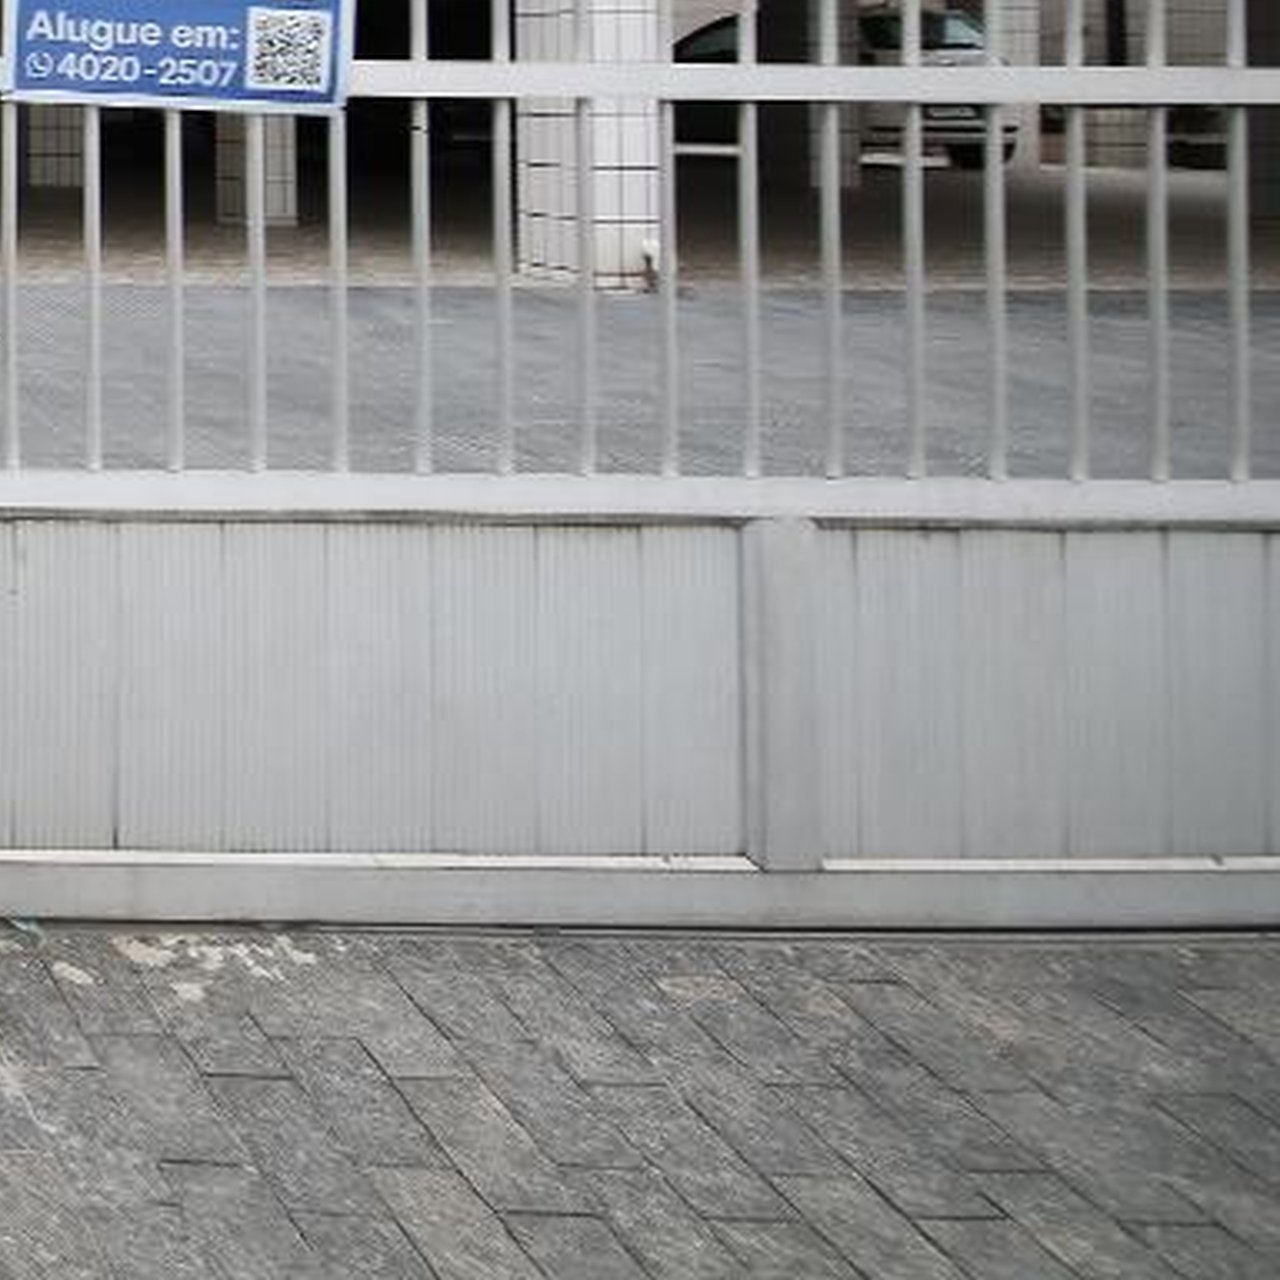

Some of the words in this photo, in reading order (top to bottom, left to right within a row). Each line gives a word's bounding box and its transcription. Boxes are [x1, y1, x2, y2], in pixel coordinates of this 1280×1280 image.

[26, 11, 161, 50] Alugue
[171, 24, 240, 51] em:
[57, 53, 238, 86] 4020-2507
